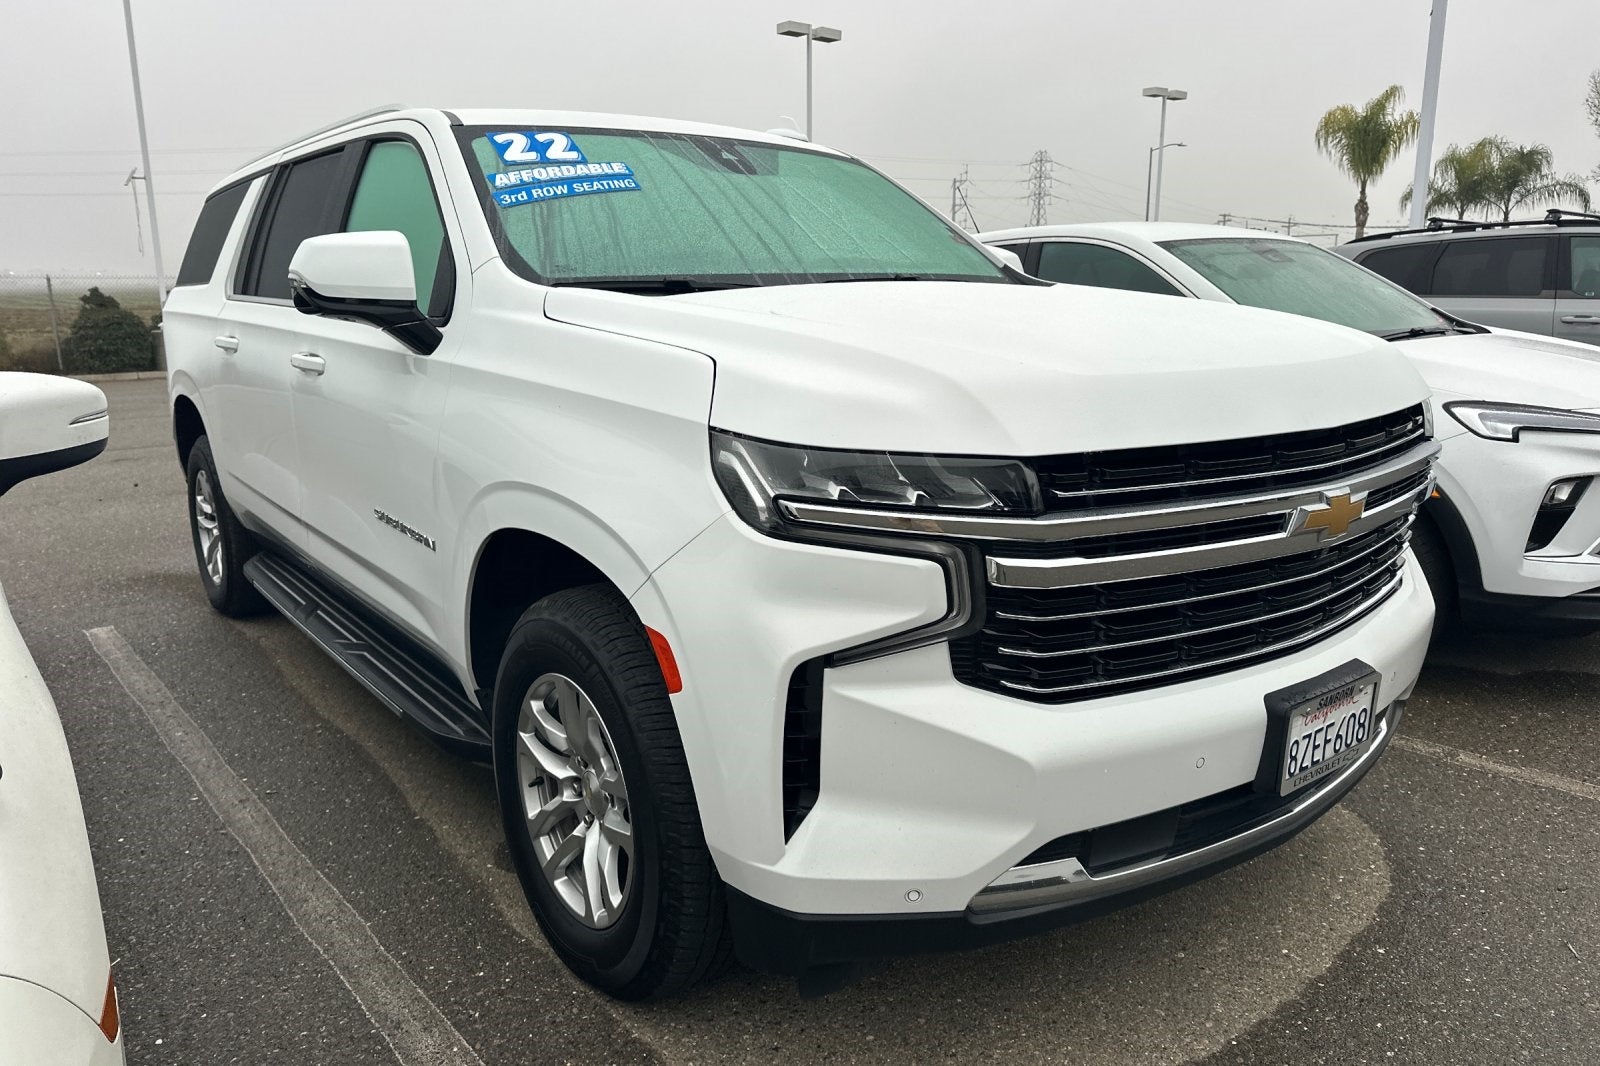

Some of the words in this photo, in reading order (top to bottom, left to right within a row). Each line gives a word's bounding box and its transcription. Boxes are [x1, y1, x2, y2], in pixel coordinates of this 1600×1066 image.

[493, 132, 580, 161] 22
[495, 162, 628, 187] AFFORDABLE
[500, 191, 528, 206] 3rd
[531, 185, 568, 199] ROW
[572, 179, 636, 193] SEATING
[373, 508, 436, 552] SUBURBAN
[1316, 684, 1356, 710] SANBORN
[1287, 707, 1368, 777] 8ZEF608
[1293, 757, 1341, 787] CHEVROLET
